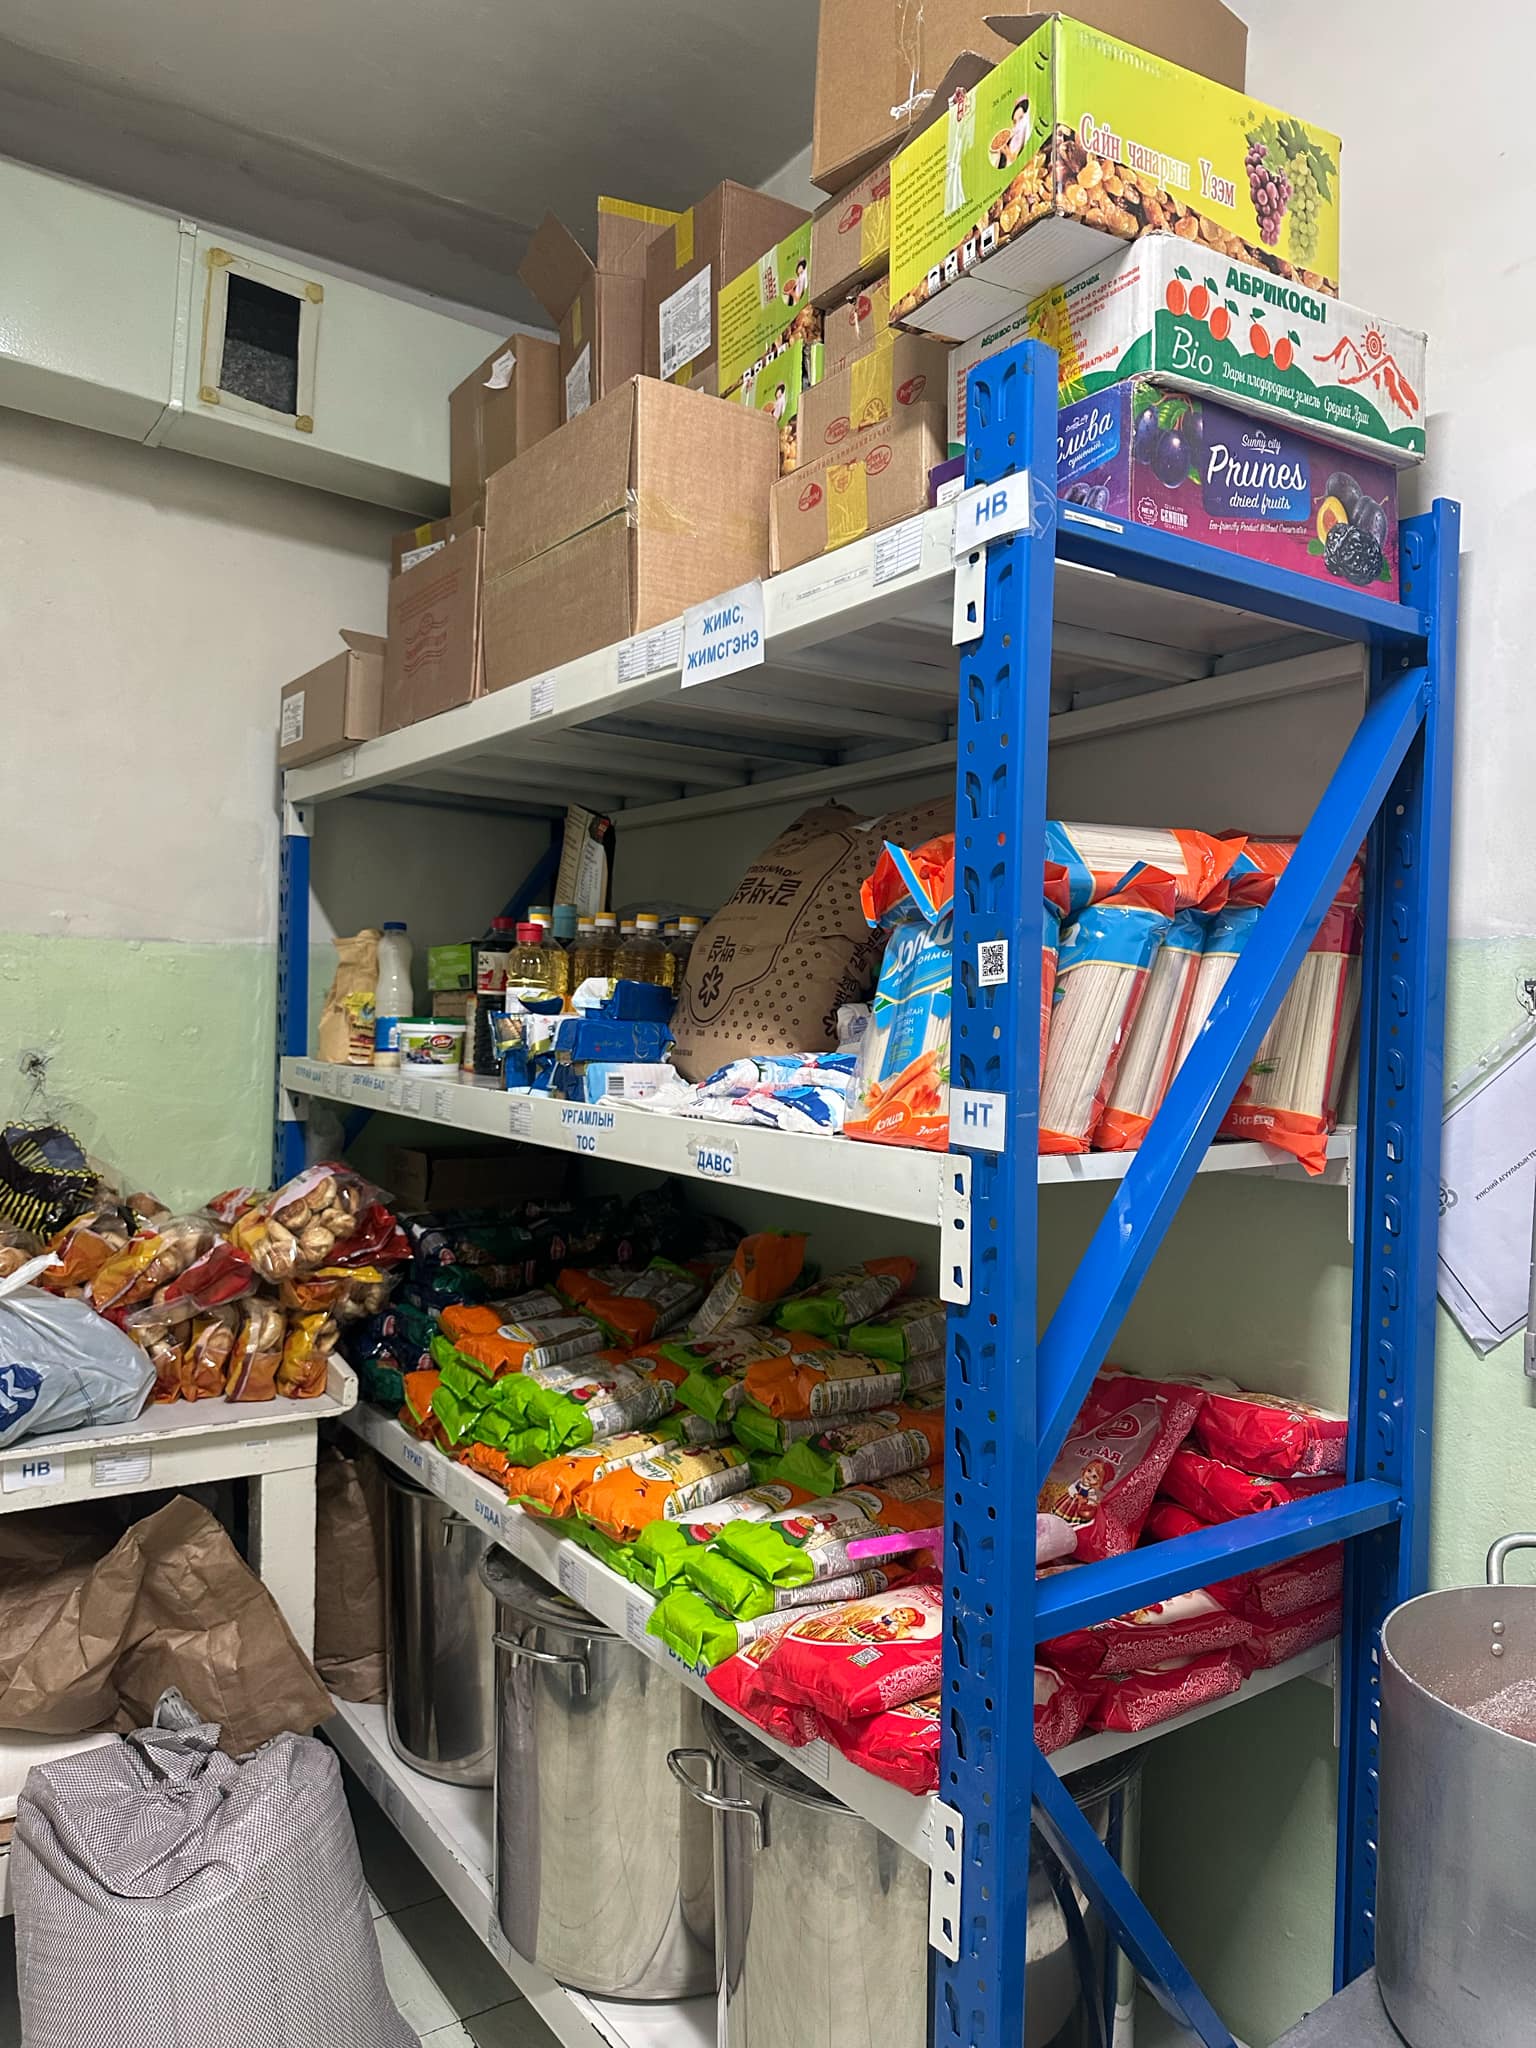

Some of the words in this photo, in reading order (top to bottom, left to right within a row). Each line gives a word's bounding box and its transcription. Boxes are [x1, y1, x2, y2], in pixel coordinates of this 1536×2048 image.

[1080, 113, 1121, 163] Сайн
[1127, 140, 1190, 191] чанарын
[1199, 157, 1236, 209] Үзэм
[1226, 267, 1326, 324] АБРИКОСЫ
[1172, 326, 1213, 375] Bio
[1223, 362, 1245, 388] Дары
[1241, 434, 1267, 455] Sunny
[1268, 437, 1282, 455] city
[1207, 444, 1306, 491] Prunes
[1229, 491, 1259, 509] dried
[1261, 494, 1291, 515] fruits
[1160, 508, 1188, 527] GENUINE
[702, 605, 744, 636] ЖИМС,
[687, 630, 759, 670] ЖИМСГЭНЭ
[561, 1108, 614, 1128] УРГАМЛЫН
[577, 1135, 595, 1151] ТОС
[697, 1150, 732, 1174] ДАВС
[475, 1499, 501, 1528] БУДАА
